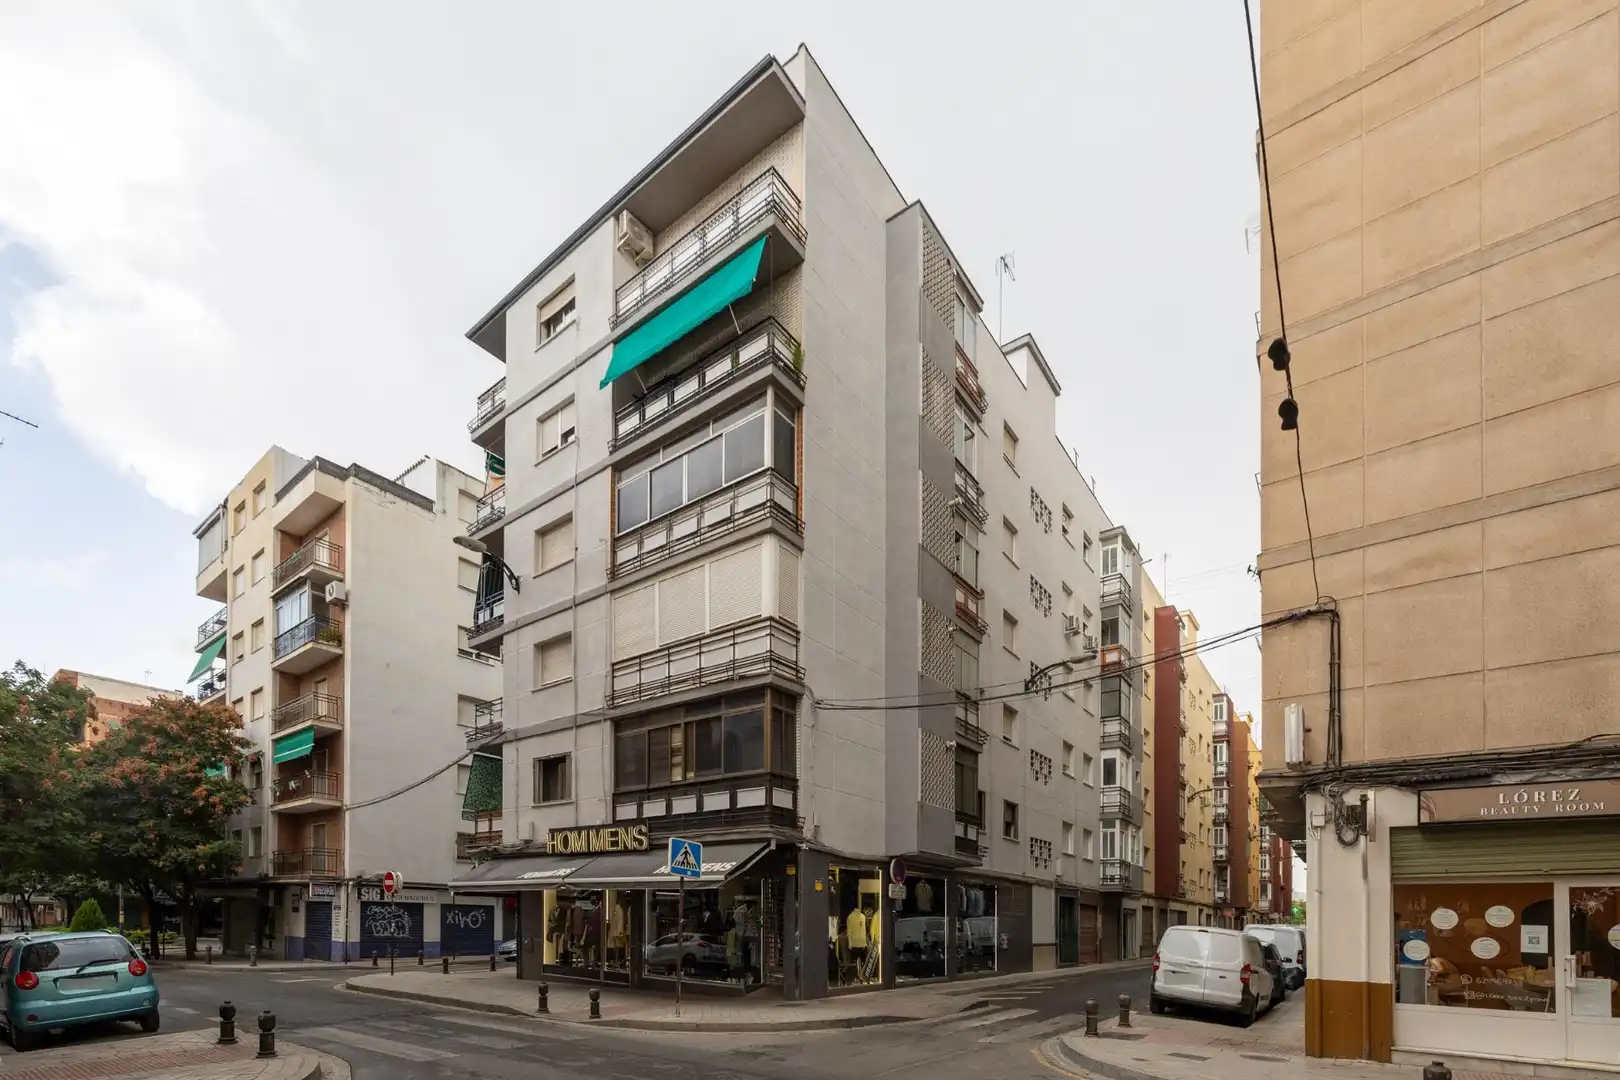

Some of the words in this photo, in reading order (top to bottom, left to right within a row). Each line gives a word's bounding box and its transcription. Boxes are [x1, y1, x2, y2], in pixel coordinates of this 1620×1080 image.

[1499, 788, 1581, 804] LÓREZ
[1480, 805, 1541, 816] BEAUTY
[1555, 802, 1605, 812] ROOM
